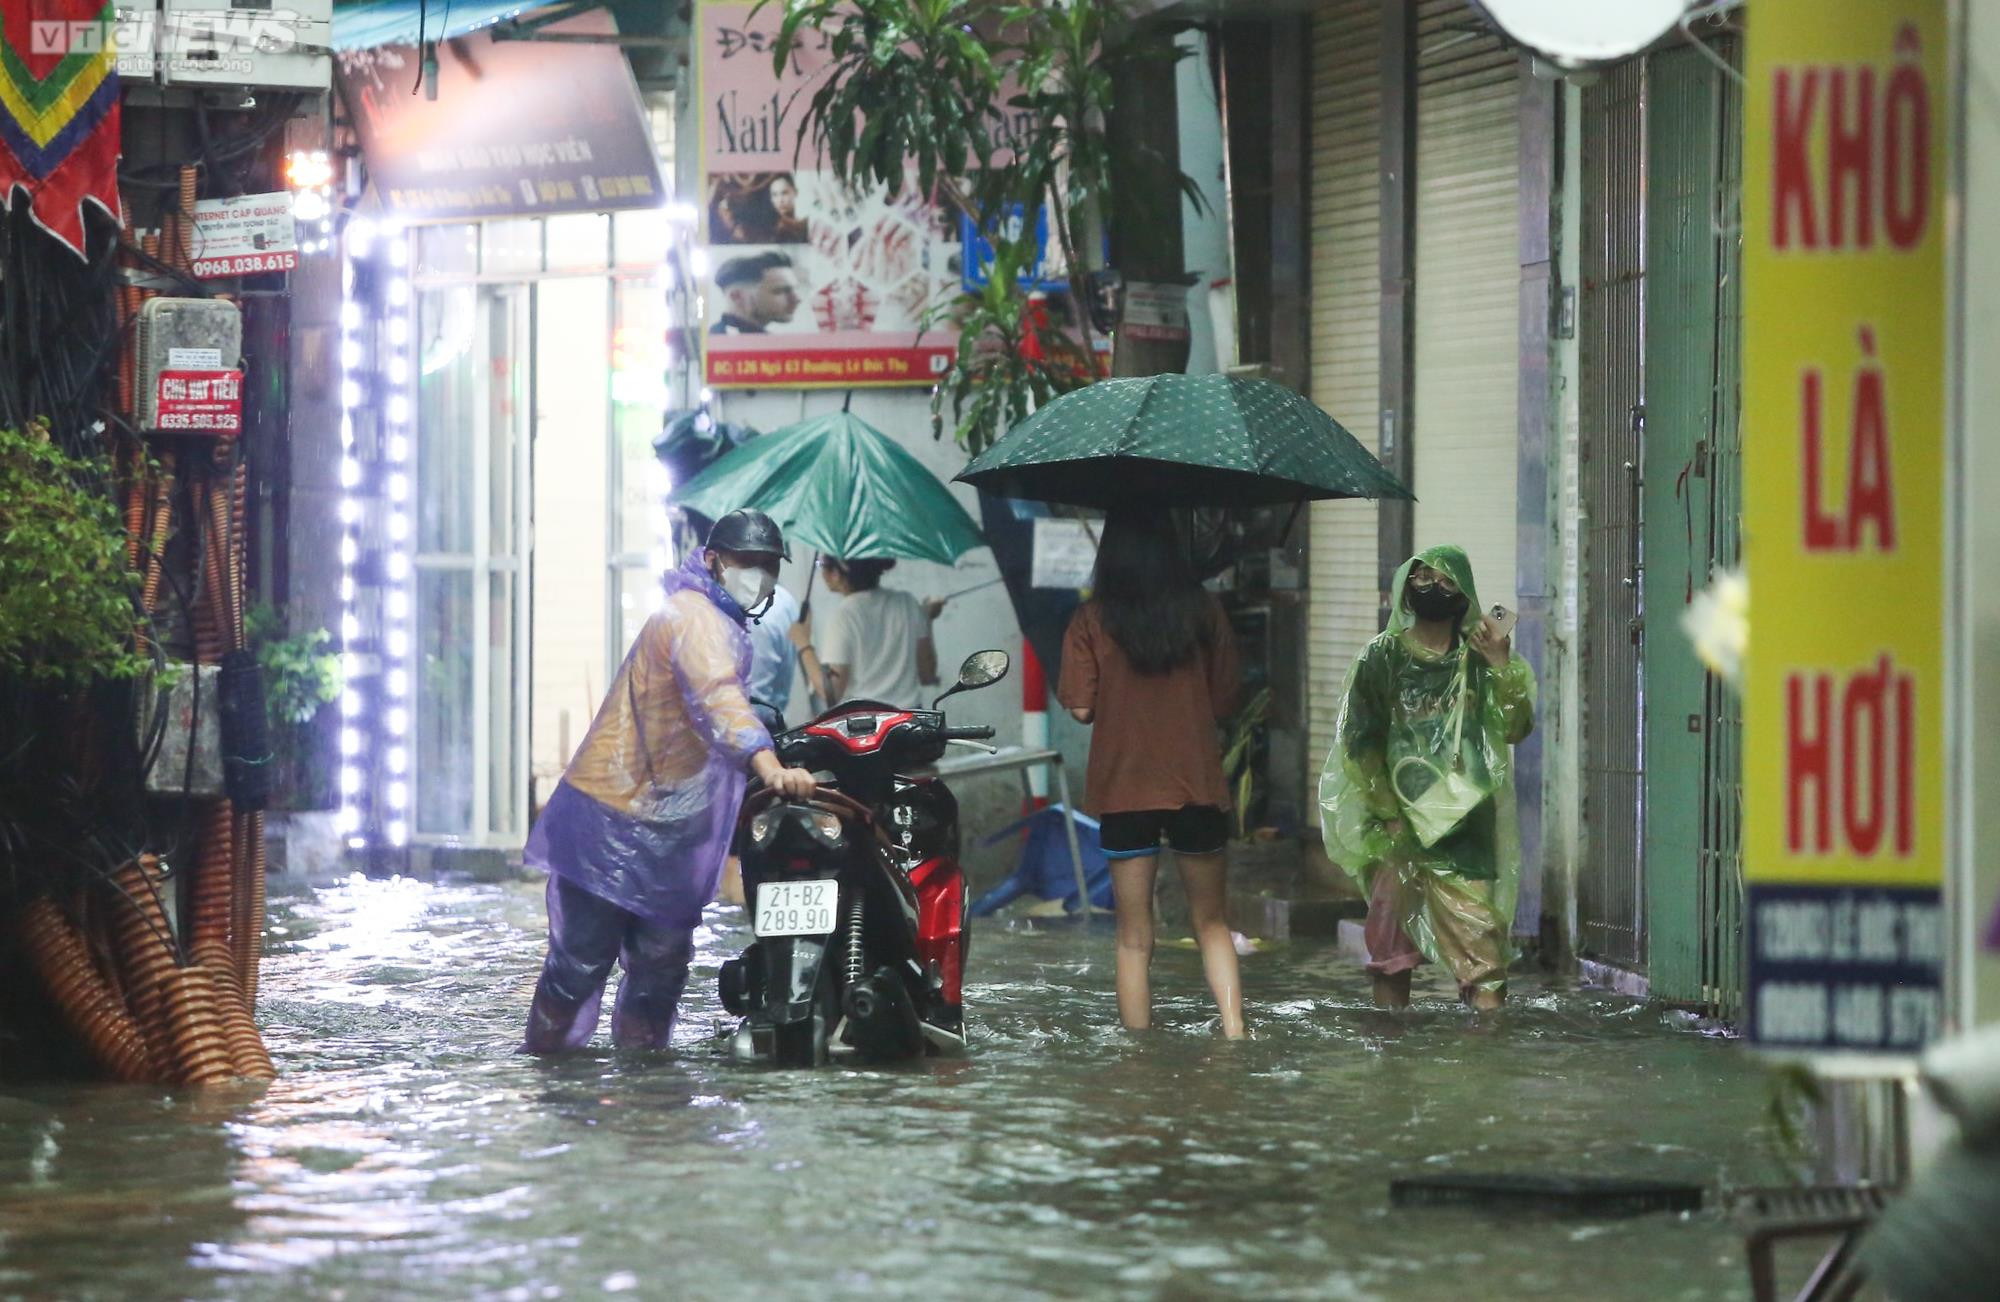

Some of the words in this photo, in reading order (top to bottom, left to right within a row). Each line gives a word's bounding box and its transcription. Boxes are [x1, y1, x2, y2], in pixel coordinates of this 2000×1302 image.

[716, 91, 781, 153] Nail
[1770, 18, 1931, 252] KHÔ
[193, 254, 295, 277] 0968.038.615
[1801, 322, 1896, 553] LÀ
[1786, 652, 1916, 857] HƠI
[761, 908, 829, 931] 289.90
[770, 885, 824, 907] 21-B2
